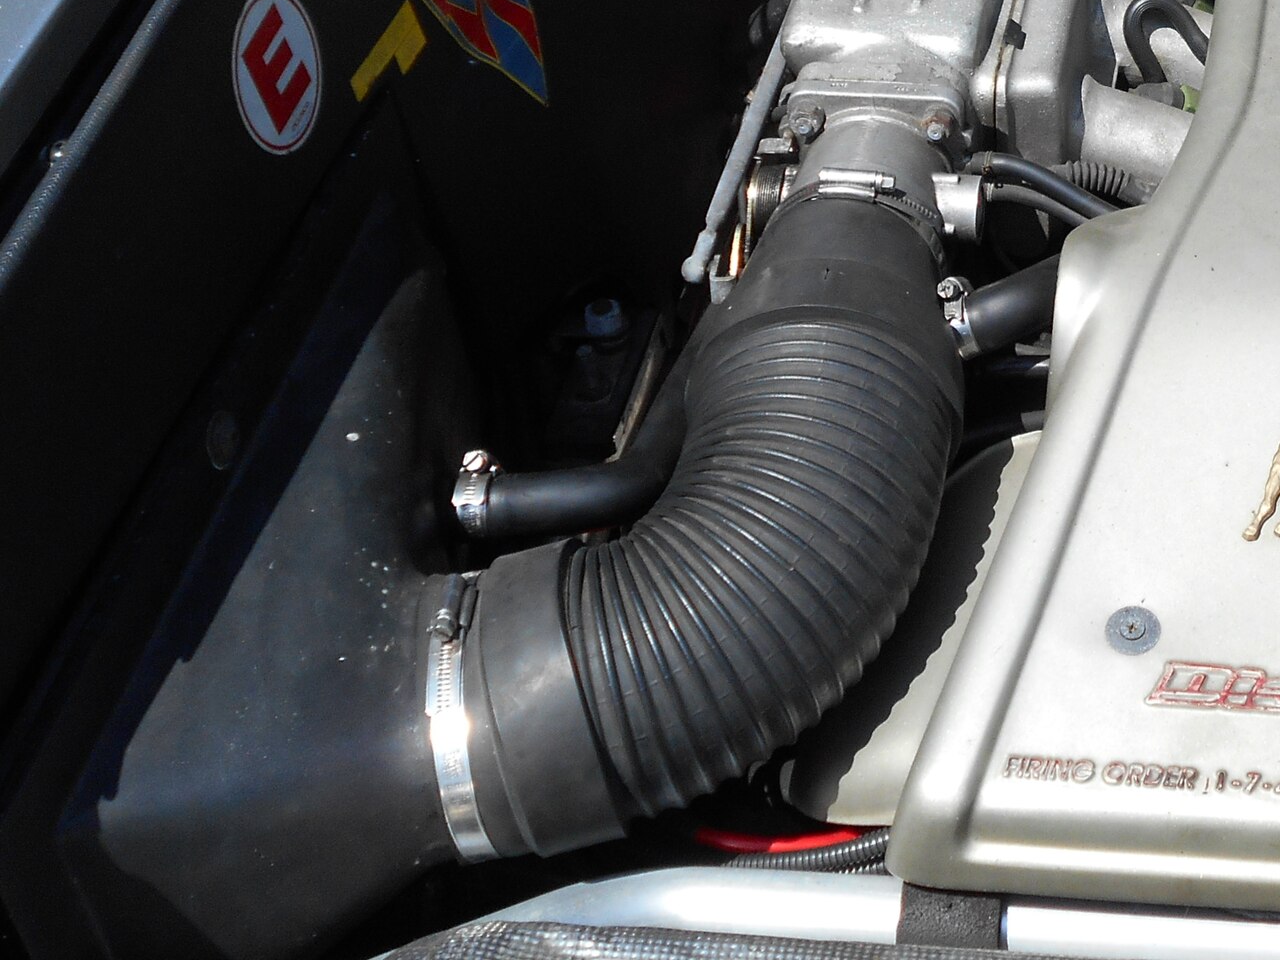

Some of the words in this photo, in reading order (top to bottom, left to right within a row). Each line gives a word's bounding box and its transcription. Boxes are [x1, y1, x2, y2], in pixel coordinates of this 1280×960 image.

[242, 4, 312, 134] E
[1003, 754, 1096, 783] FIRING
[1101, 760, 1200, 790] ORDER
